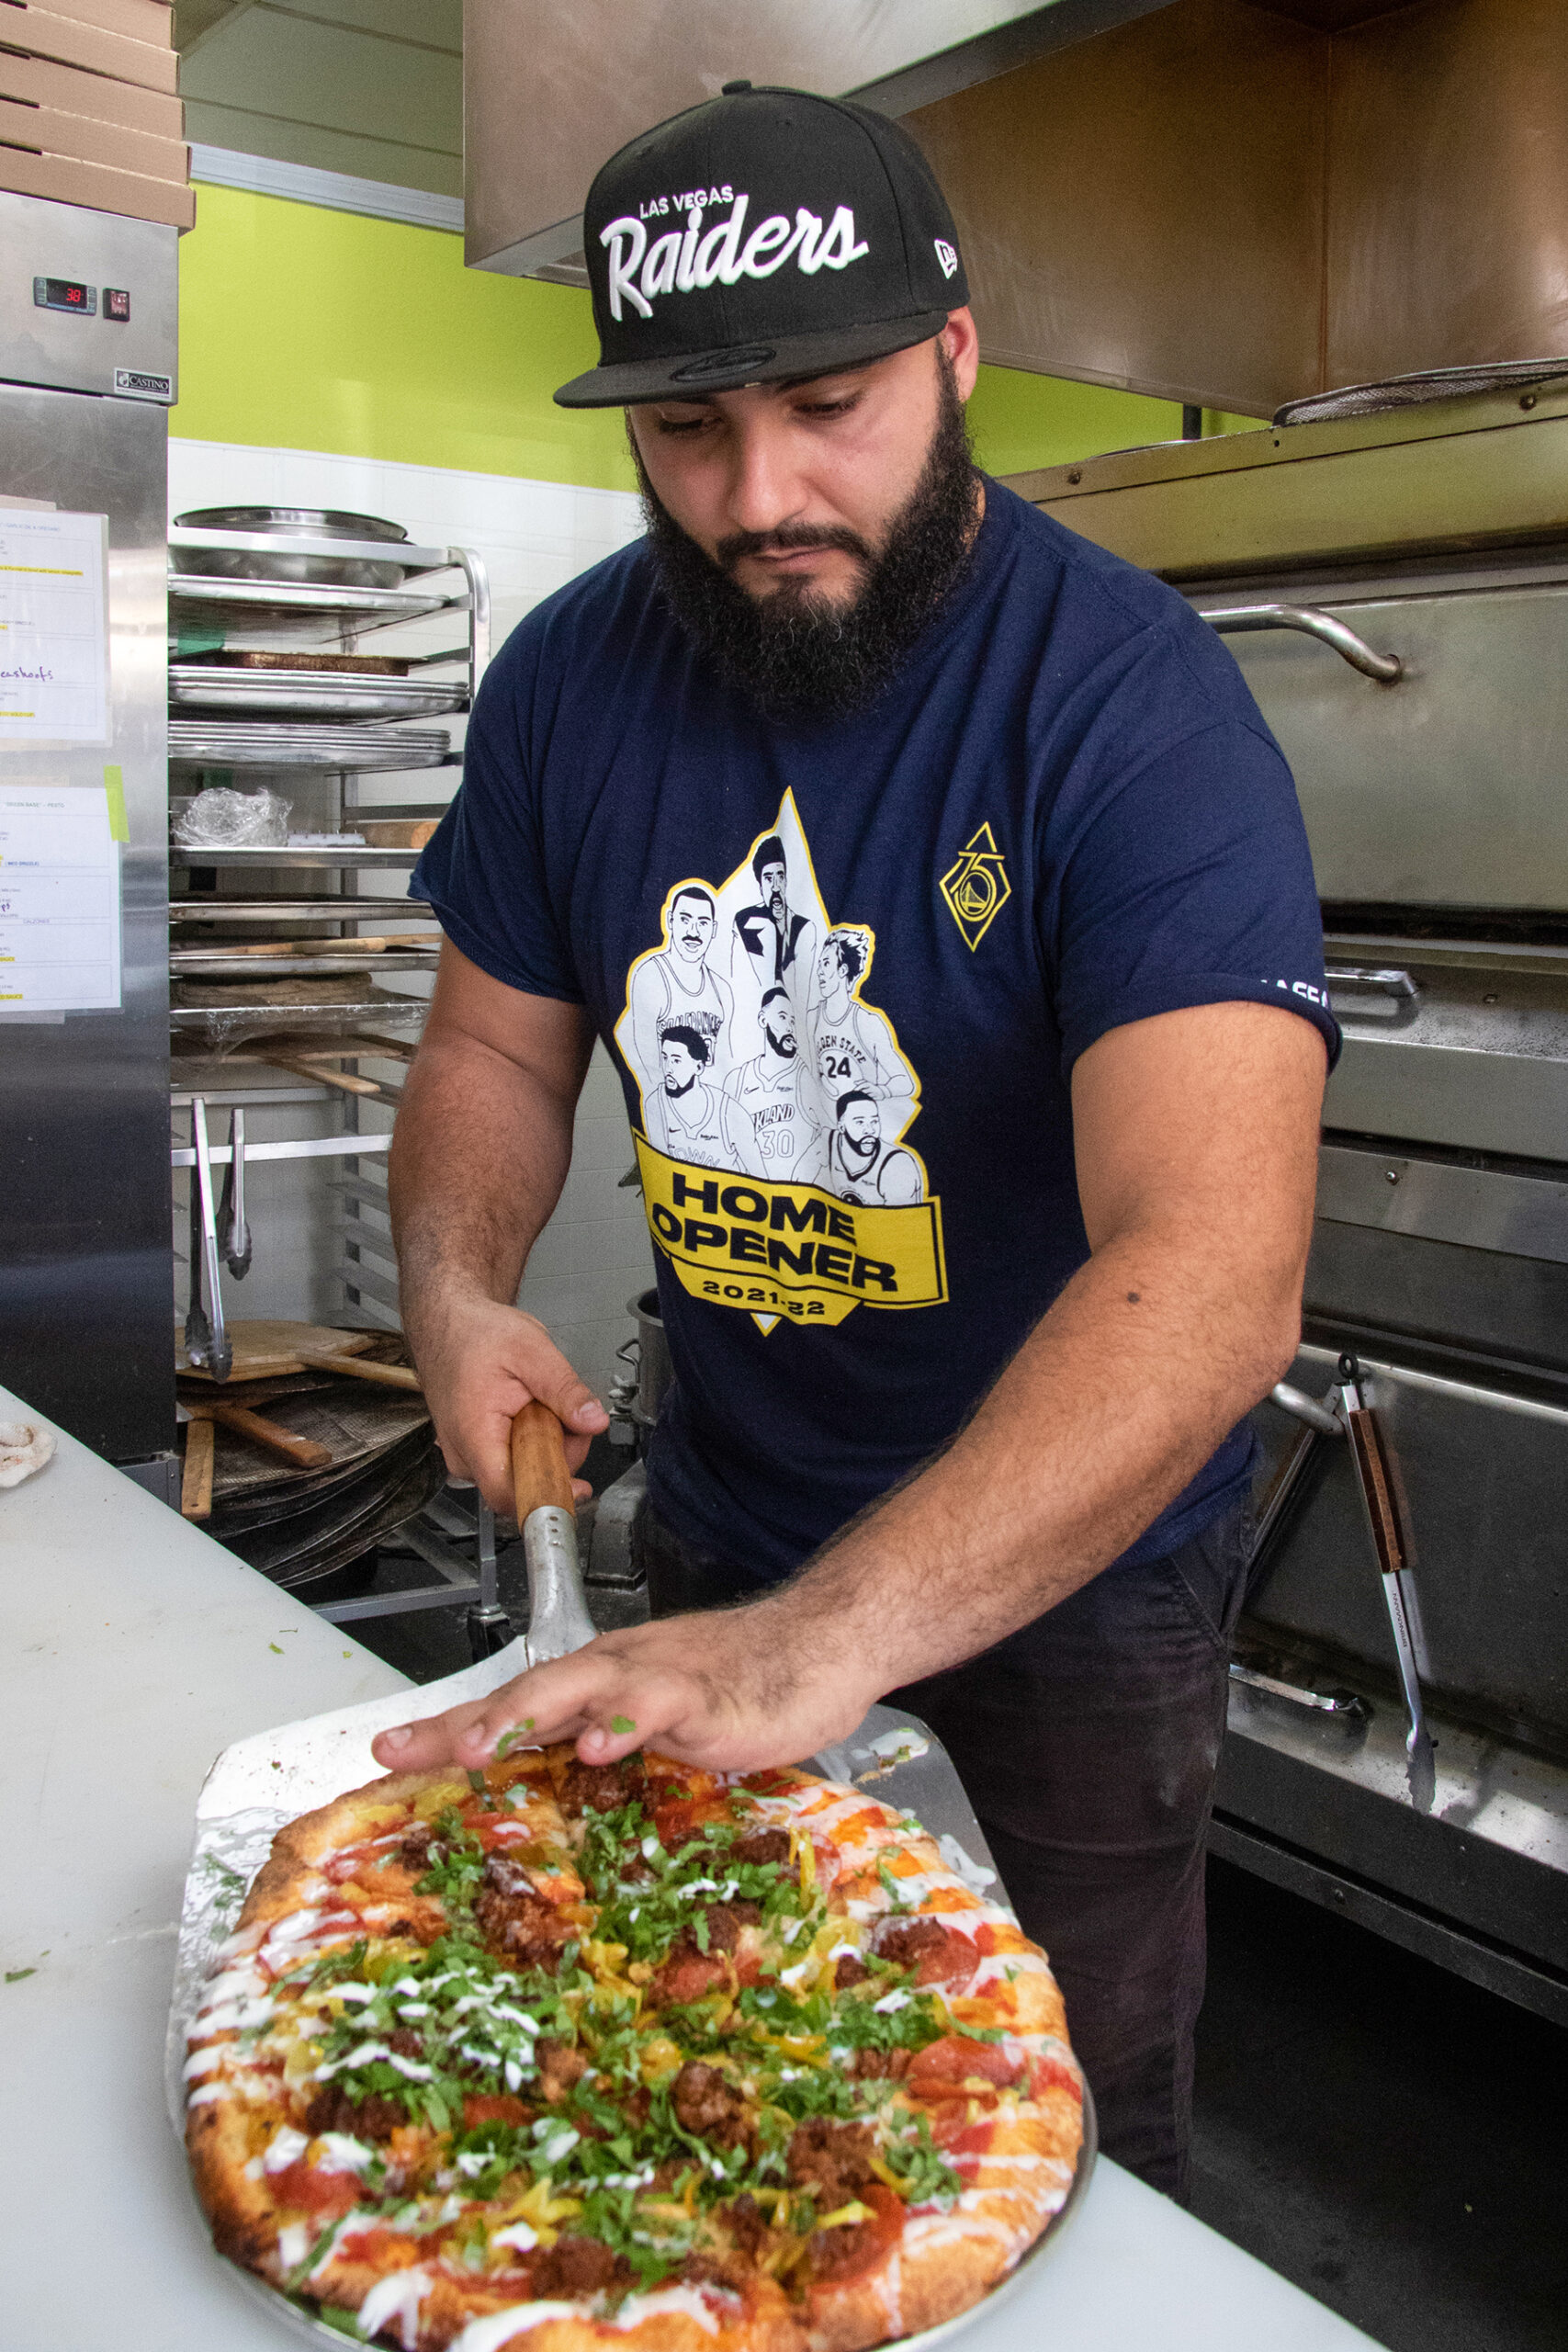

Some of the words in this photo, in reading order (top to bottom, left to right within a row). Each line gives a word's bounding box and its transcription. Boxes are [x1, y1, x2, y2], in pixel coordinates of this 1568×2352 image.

[639, 197, 670, 220] LAS
[673, 185, 734, 212] VEGAS
[599, 194, 870, 322] Raiders
[66, 288, 82, 302] 38
[130, 376, 169, 390] CASTINO
[840, 1037, 866, 1064] STATE
[825, 1056, 852, 1079] 24
[761, 1128, 795, 1159] 30
[671, 1171, 856, 1247] HOME
[652, 1202, 898, 1292] OPENER
[702, 1280, 826, 1317] 2021-22
